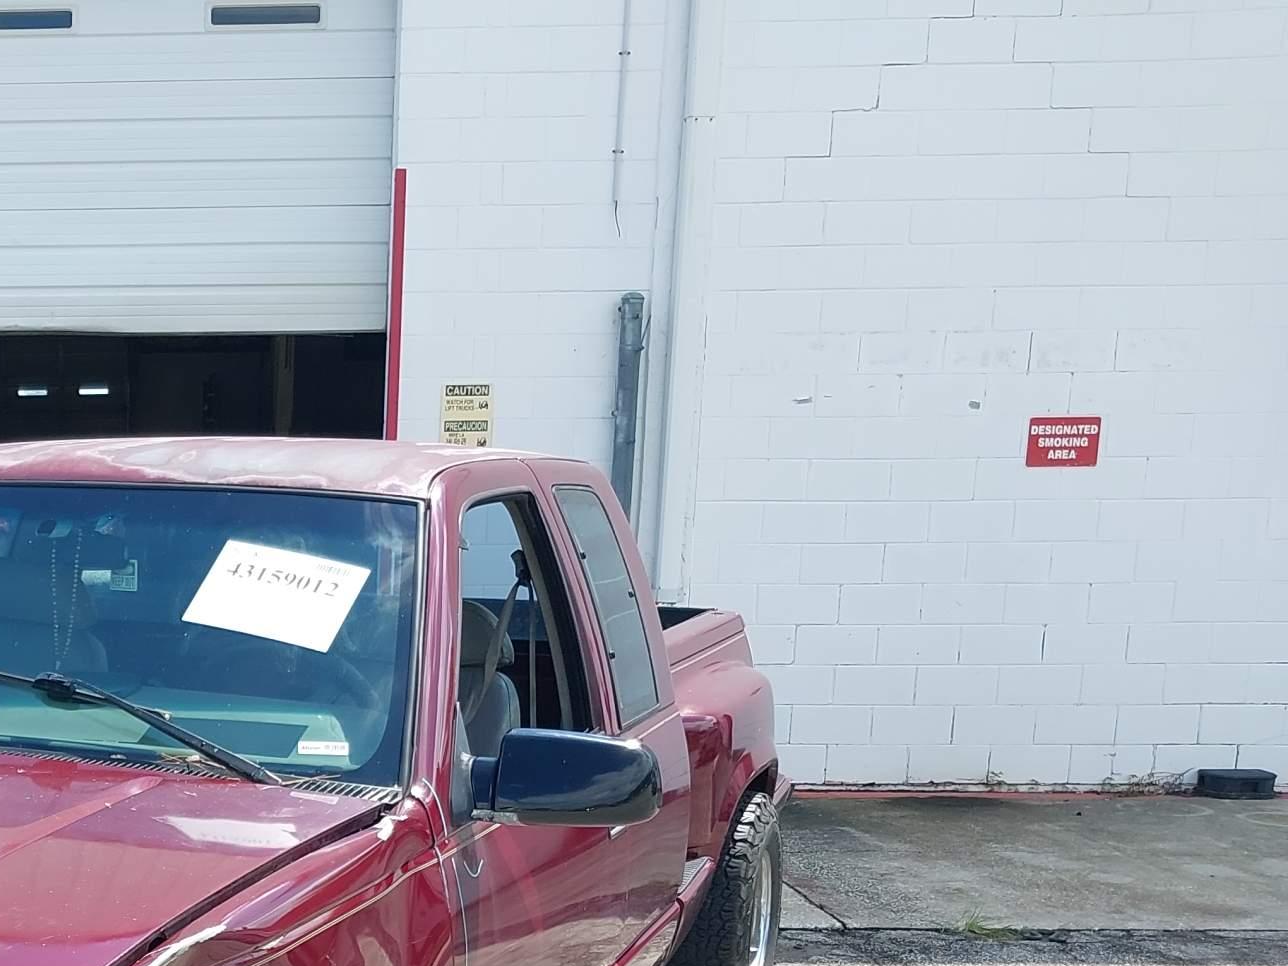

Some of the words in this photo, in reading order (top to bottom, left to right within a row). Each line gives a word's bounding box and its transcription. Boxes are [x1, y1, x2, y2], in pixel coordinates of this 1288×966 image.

[446, 385, 489, 396] CAUTION
[1030, 424, 1099, 435] DESIGNATED
[1038, 436, 1089, 448] SMOKING
[1047, 449, 1076, 460] AREA
[227, 562, 340, 597] 43159012
